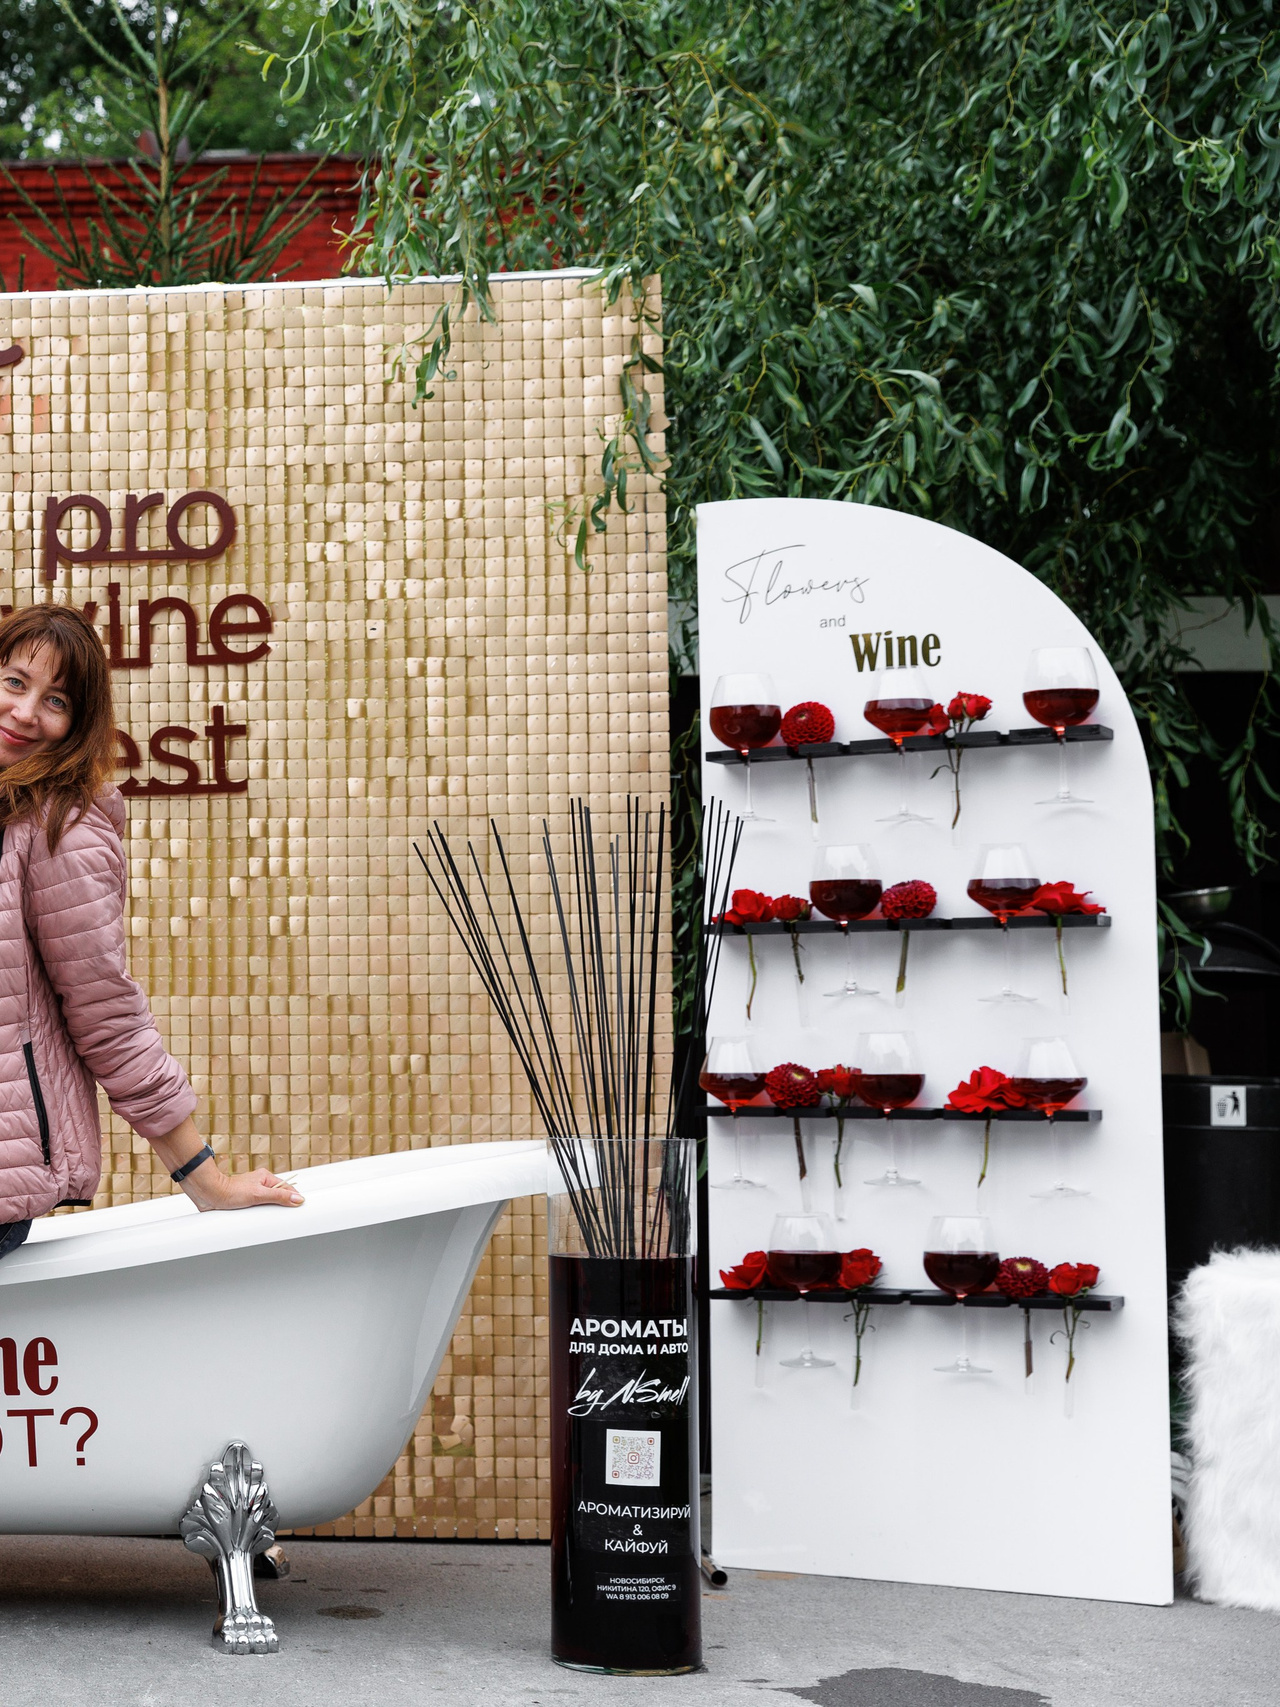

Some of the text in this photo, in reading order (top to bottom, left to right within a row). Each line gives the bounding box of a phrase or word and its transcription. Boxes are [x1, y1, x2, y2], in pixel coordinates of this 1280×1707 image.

[46, 491, 236, 581] pro
[722, 544, 870, 625] Flowers
[0, 582, 274, 669] ine
[819, 615, 847, 628] and
[849, 630, 942, 673] Wine
[115, 705, 248, 796] est
[569, 1318, 688, 1338] АРОМАТЫ
[569, 1341, 689, 1356] ДЛЯ ДОМА И АВТО
[567, 1367, 605, 1417] by
[577, 1500, 691, 1519] АРОМАТИЗИРУЙ
[632, 1523, 643, 1536] &
[604, 1538, 669, 1554] КАЙФУЙ
[638, 1585, 651, 1593] 120,
[651, 1584, 671, 1592] ОФИС
